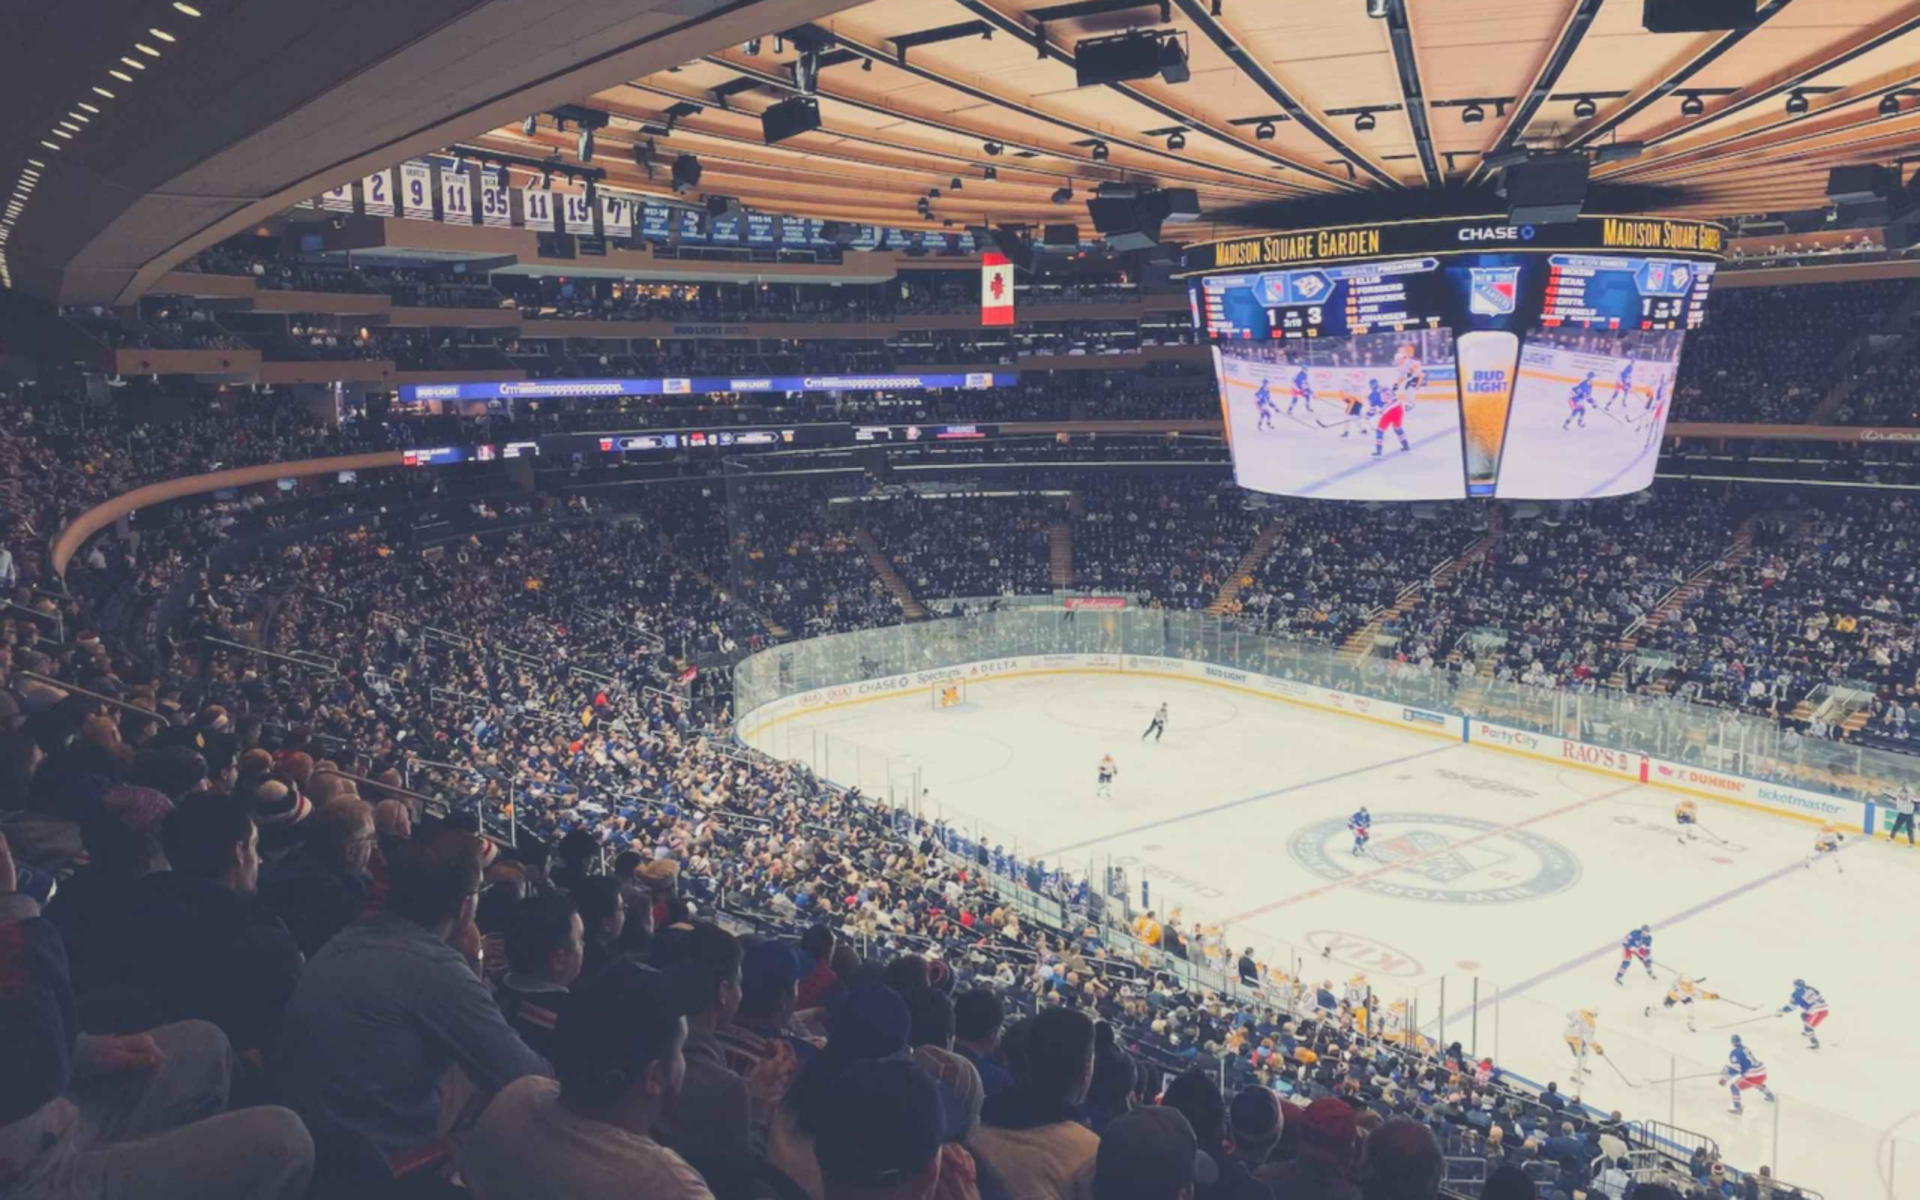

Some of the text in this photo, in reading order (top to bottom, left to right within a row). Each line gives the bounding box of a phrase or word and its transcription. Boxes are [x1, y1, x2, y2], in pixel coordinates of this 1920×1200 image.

[371, 174, 385, 202] 2
[410, 179, 424, 206] 9
[447, 185, 466, 212] 11
[483, 187, 508, 215] 35
[528, 194, 548, 220] 11
[1458, 226, 1518, 241] CHASE
[1603, 219, 1660, 246] MADISON
[1663, 221, 1698, 250] SQUARE
[1215, 230, 1380, 266] MADISON SQUARE GARDEN
[1307, 306, 1322, 325] 3
[1642, 298, 1651, 316] 1
[1671, 299, 1682, 317] 3
[1266, 308, 1277, 327] 1
[1473, 370, 1505, 382] BUD
[1467, 381, 1509, 394] LIGHT
[981, 661, 1018, 673] DELTA
[1223, 671, 1247, 683] LIGHT
[858, 680, 898, 694] CHASE
[1562, 741, 1614, 768] RAO'S
[1757, 787, 1842, 814] ticketmaster
